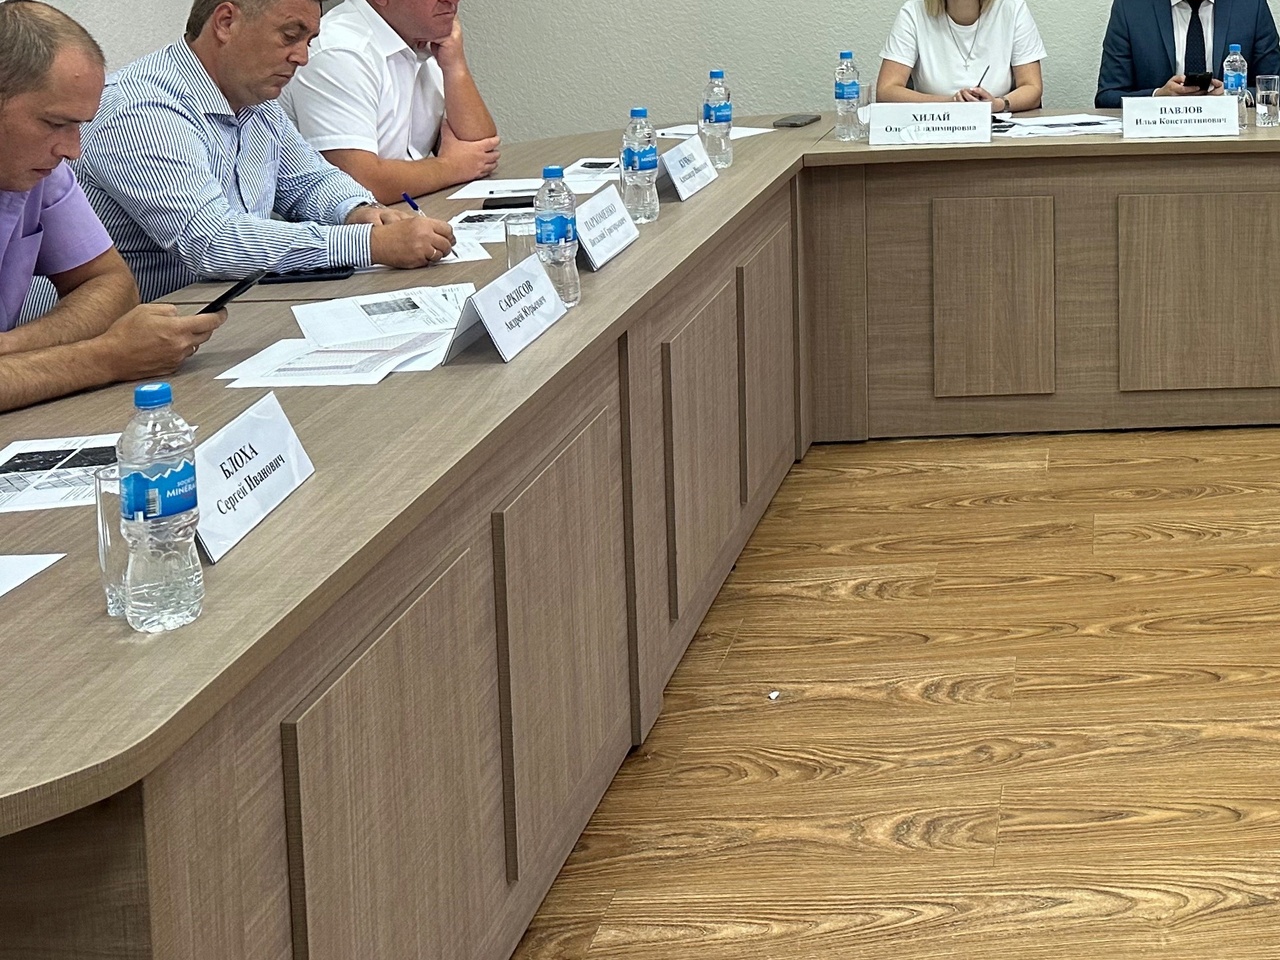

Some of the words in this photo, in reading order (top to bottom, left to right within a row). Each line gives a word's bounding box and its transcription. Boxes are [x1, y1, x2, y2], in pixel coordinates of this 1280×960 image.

[912, 112, 950, 122] ХИЛАЙ
[1159, 117, 1227, 125] Константинович
[1160, 106, 1203, 115] ПАВЛОВ
[498, 279, 534, 313] САРКИСОВ
[504, 310, 526, 333] Андрей
[219, 442, 259, 481] БЛОХА
[216, 482, 249, 515] Сергей
[243, 453, 286, 492] Иванович
